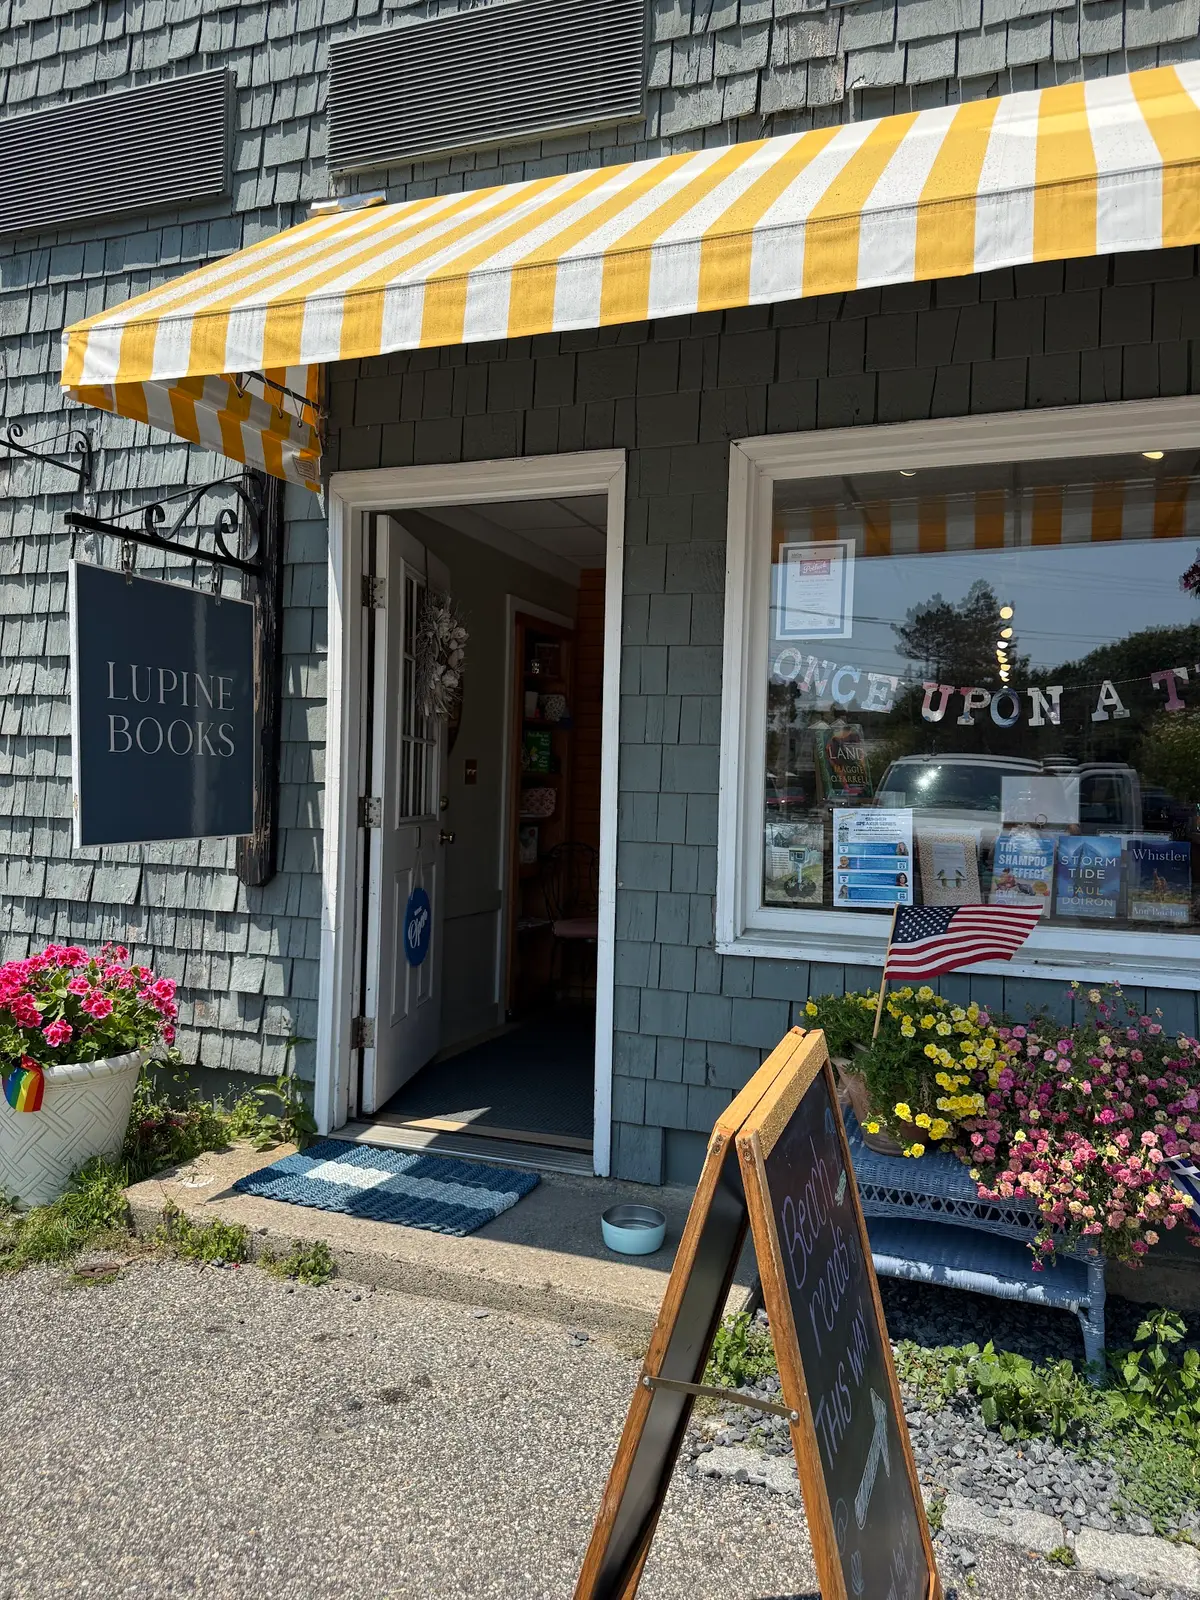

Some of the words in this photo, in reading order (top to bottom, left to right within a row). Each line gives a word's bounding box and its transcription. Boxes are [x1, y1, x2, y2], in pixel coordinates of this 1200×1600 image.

[106, 660, 235, 711] LUPINE
[773, 647, 899, 714] ONCE
[921, 681, 1063, 728] UPON
[1091, 680, 1131, 722] A
[1151, 663, 1200, 712] T
[107, 714, 235, 758] BOOKS
[828, 746, 866, 761] LAND
[999, 842, 1017, 852] THE
[998, 854, 1047, 867] SHAMPOO
[1061, 855, 1116, 867] STORM
[1132, 848, 1188, 862] Whistler
[1013, 867, 1045, 880] EFFECT
[1068, 868, 1106, 880] TIDE
[1067, 885, 1104, 896] PAUL
[1061, 896, 1114, 908] DOIRON
[408, 908, 428, 949] Open
[781, 1135, 835, 1290] Beach
[809, 1217, 850, 1357] reads
[815, 1361, 852, 1471] THIS
[846, 1296, 870, 1388] WAY
